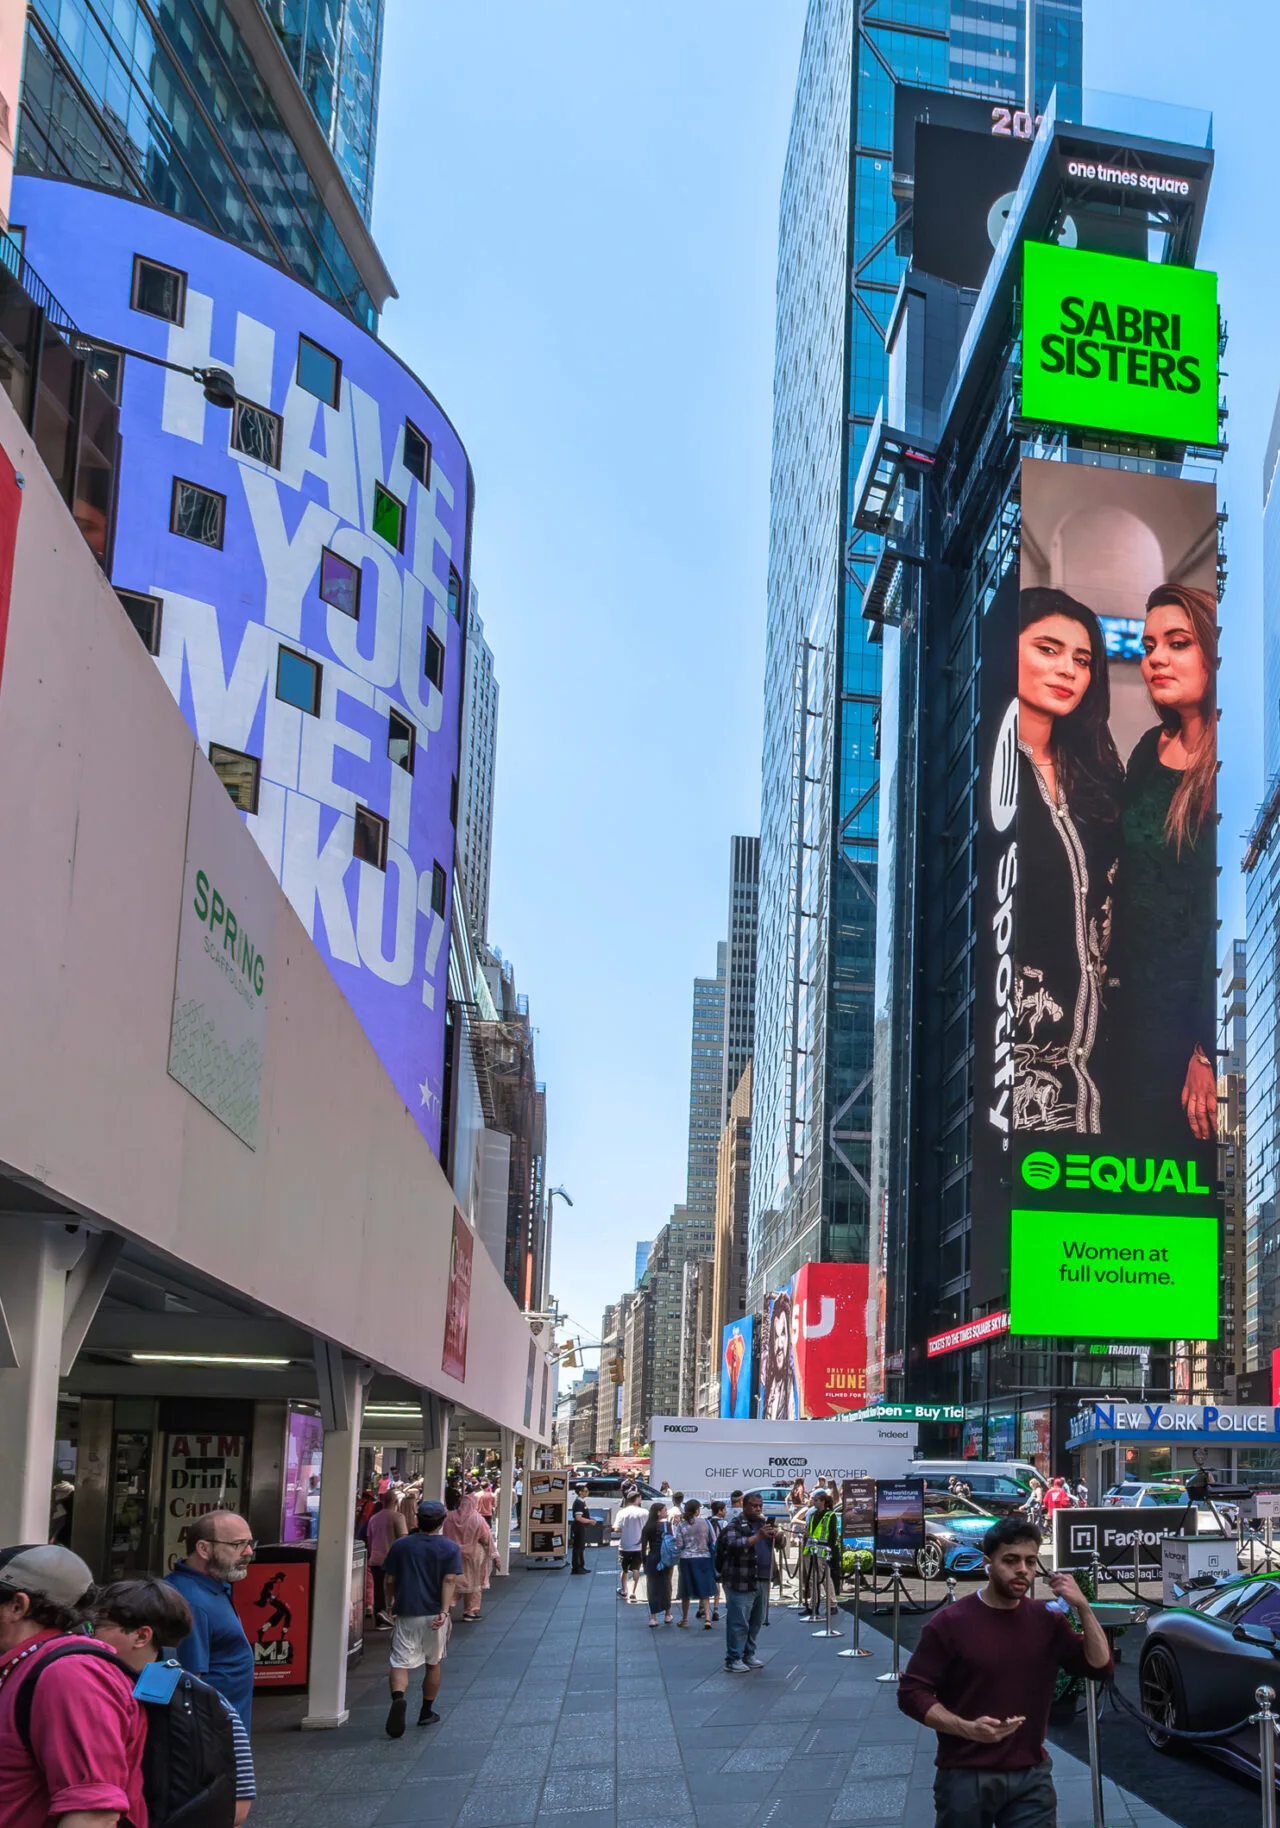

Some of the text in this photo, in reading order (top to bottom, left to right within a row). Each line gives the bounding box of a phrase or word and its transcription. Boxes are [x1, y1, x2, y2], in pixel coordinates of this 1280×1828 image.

[1068, 161, 1190, 195] one times square
[1060, 295, 1182, 352] SABRI
[1040, 334, 1201, 395] SISTERS
[161, 288, 455, 604] HAVE
[238, 462, 448, 732] YOU
[149, 586, 428, 850] MET
[194, 869, 265, 997] SPRING
[1066, 1154, 1210, 1195] EQUAL
[1062, 1241, 1169, 1263] Women at
[1059, 1264, 1176, 1287] full volume.
[825, 1374, 866, 1389] JUNE
[915, 1406, 940, 1421] Buy
[664, 1424, 698, 1433] FOX ONE
[878, 1430, 909, 1439] indeed
[171, 1436, 240, 1457] ATM
[705, 1467, 868, 1478] CHIEF WORLD CUP WATCHER
[768, 1457, 808, 1467] FOX ONE
[170, 1467, 238, 1489] Drink
[254, 1640, 289, 1660] MJ
